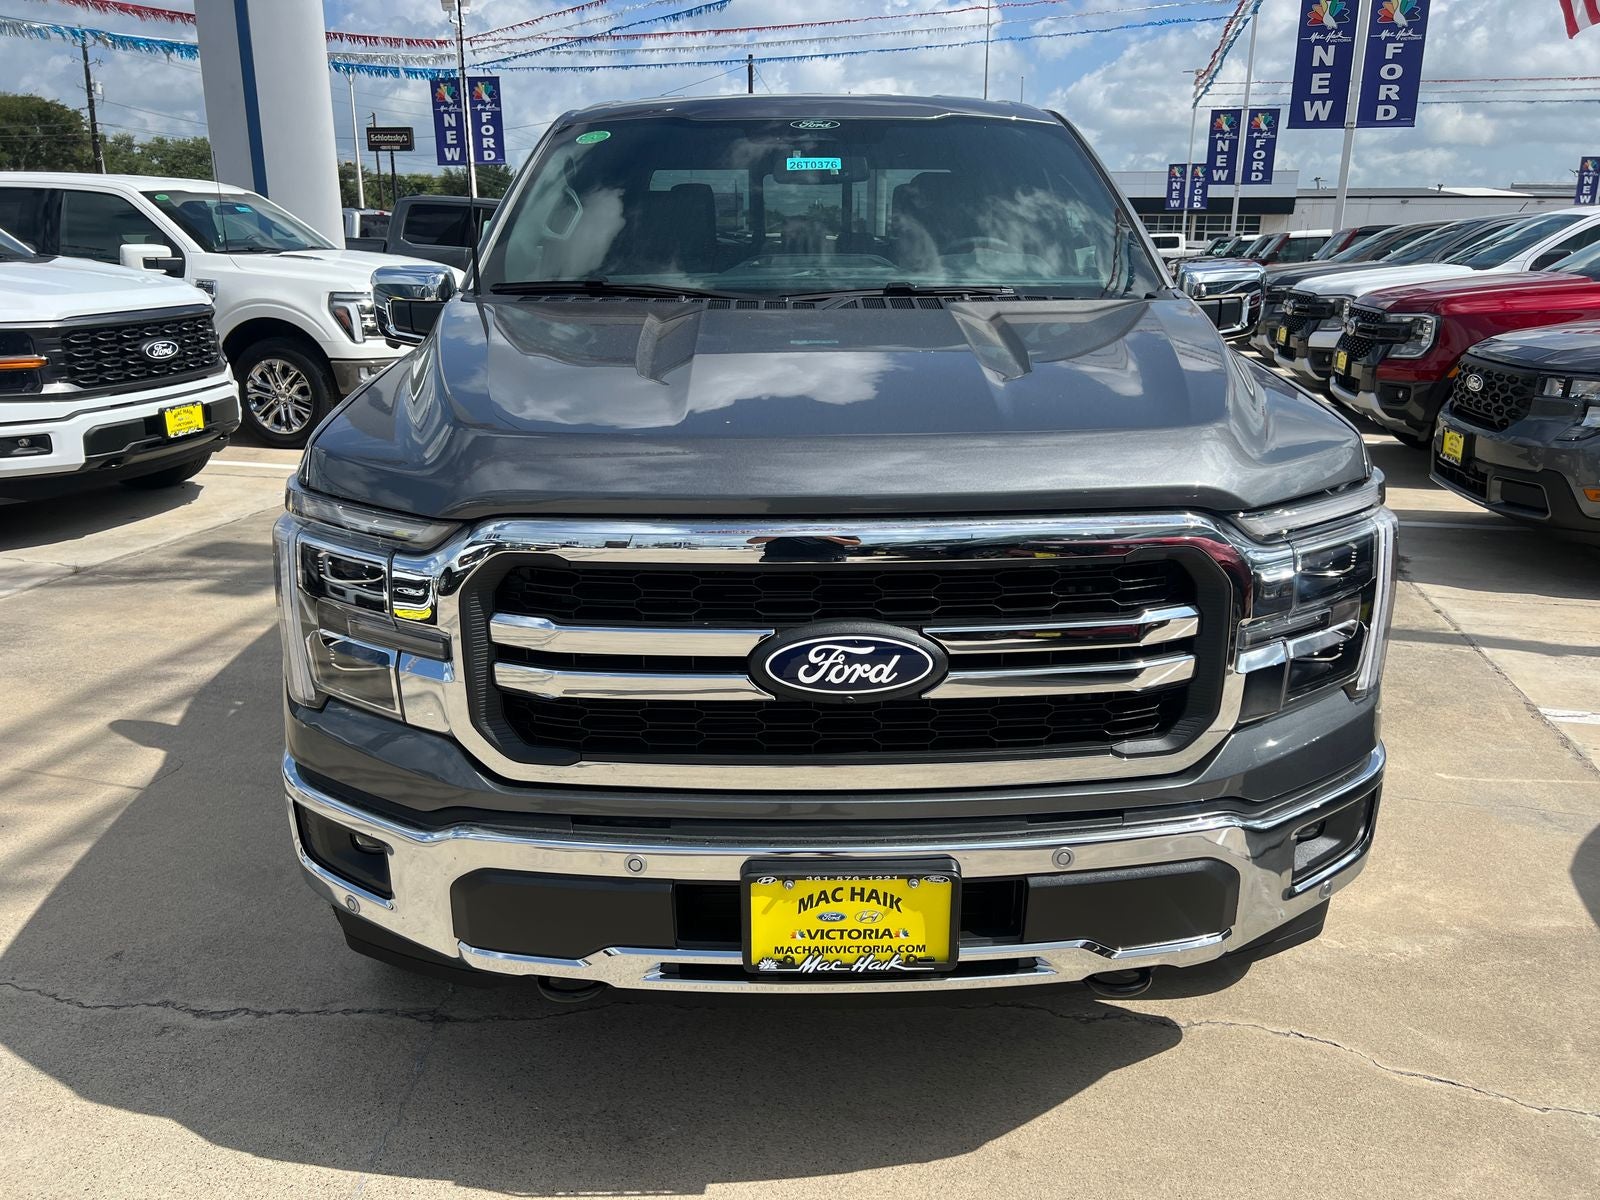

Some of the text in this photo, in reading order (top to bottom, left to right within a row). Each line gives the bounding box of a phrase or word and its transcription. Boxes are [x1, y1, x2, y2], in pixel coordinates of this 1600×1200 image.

[1303, 45, 1336, 121] NEW
[1375, 43, 1404, 120] FORD
[443, 113, 461, 161] NEW
[481, 112, 496, 161] FORD
[790, 160, 838, 169] 26T0376
[1212, 140, 1229, 181] NEW
[1250, 139, 1266, 181] FORD
[1170, 182, 1181, 207] NEW
[1193, 182, 1203, 208] FORD
[1580, 176, 1594, 203] NEW
[152, 343, 173, 356] Ford
[797, 644, 900, 684] Ford
[797, 886, 903, 914] MAC HAIK
[806, 928, 894, 940] VICTORIA
[774, 944, 926, 955] MACHAIKVICTORIA.COM
[798, 953, 905, 973] Mac Haik
